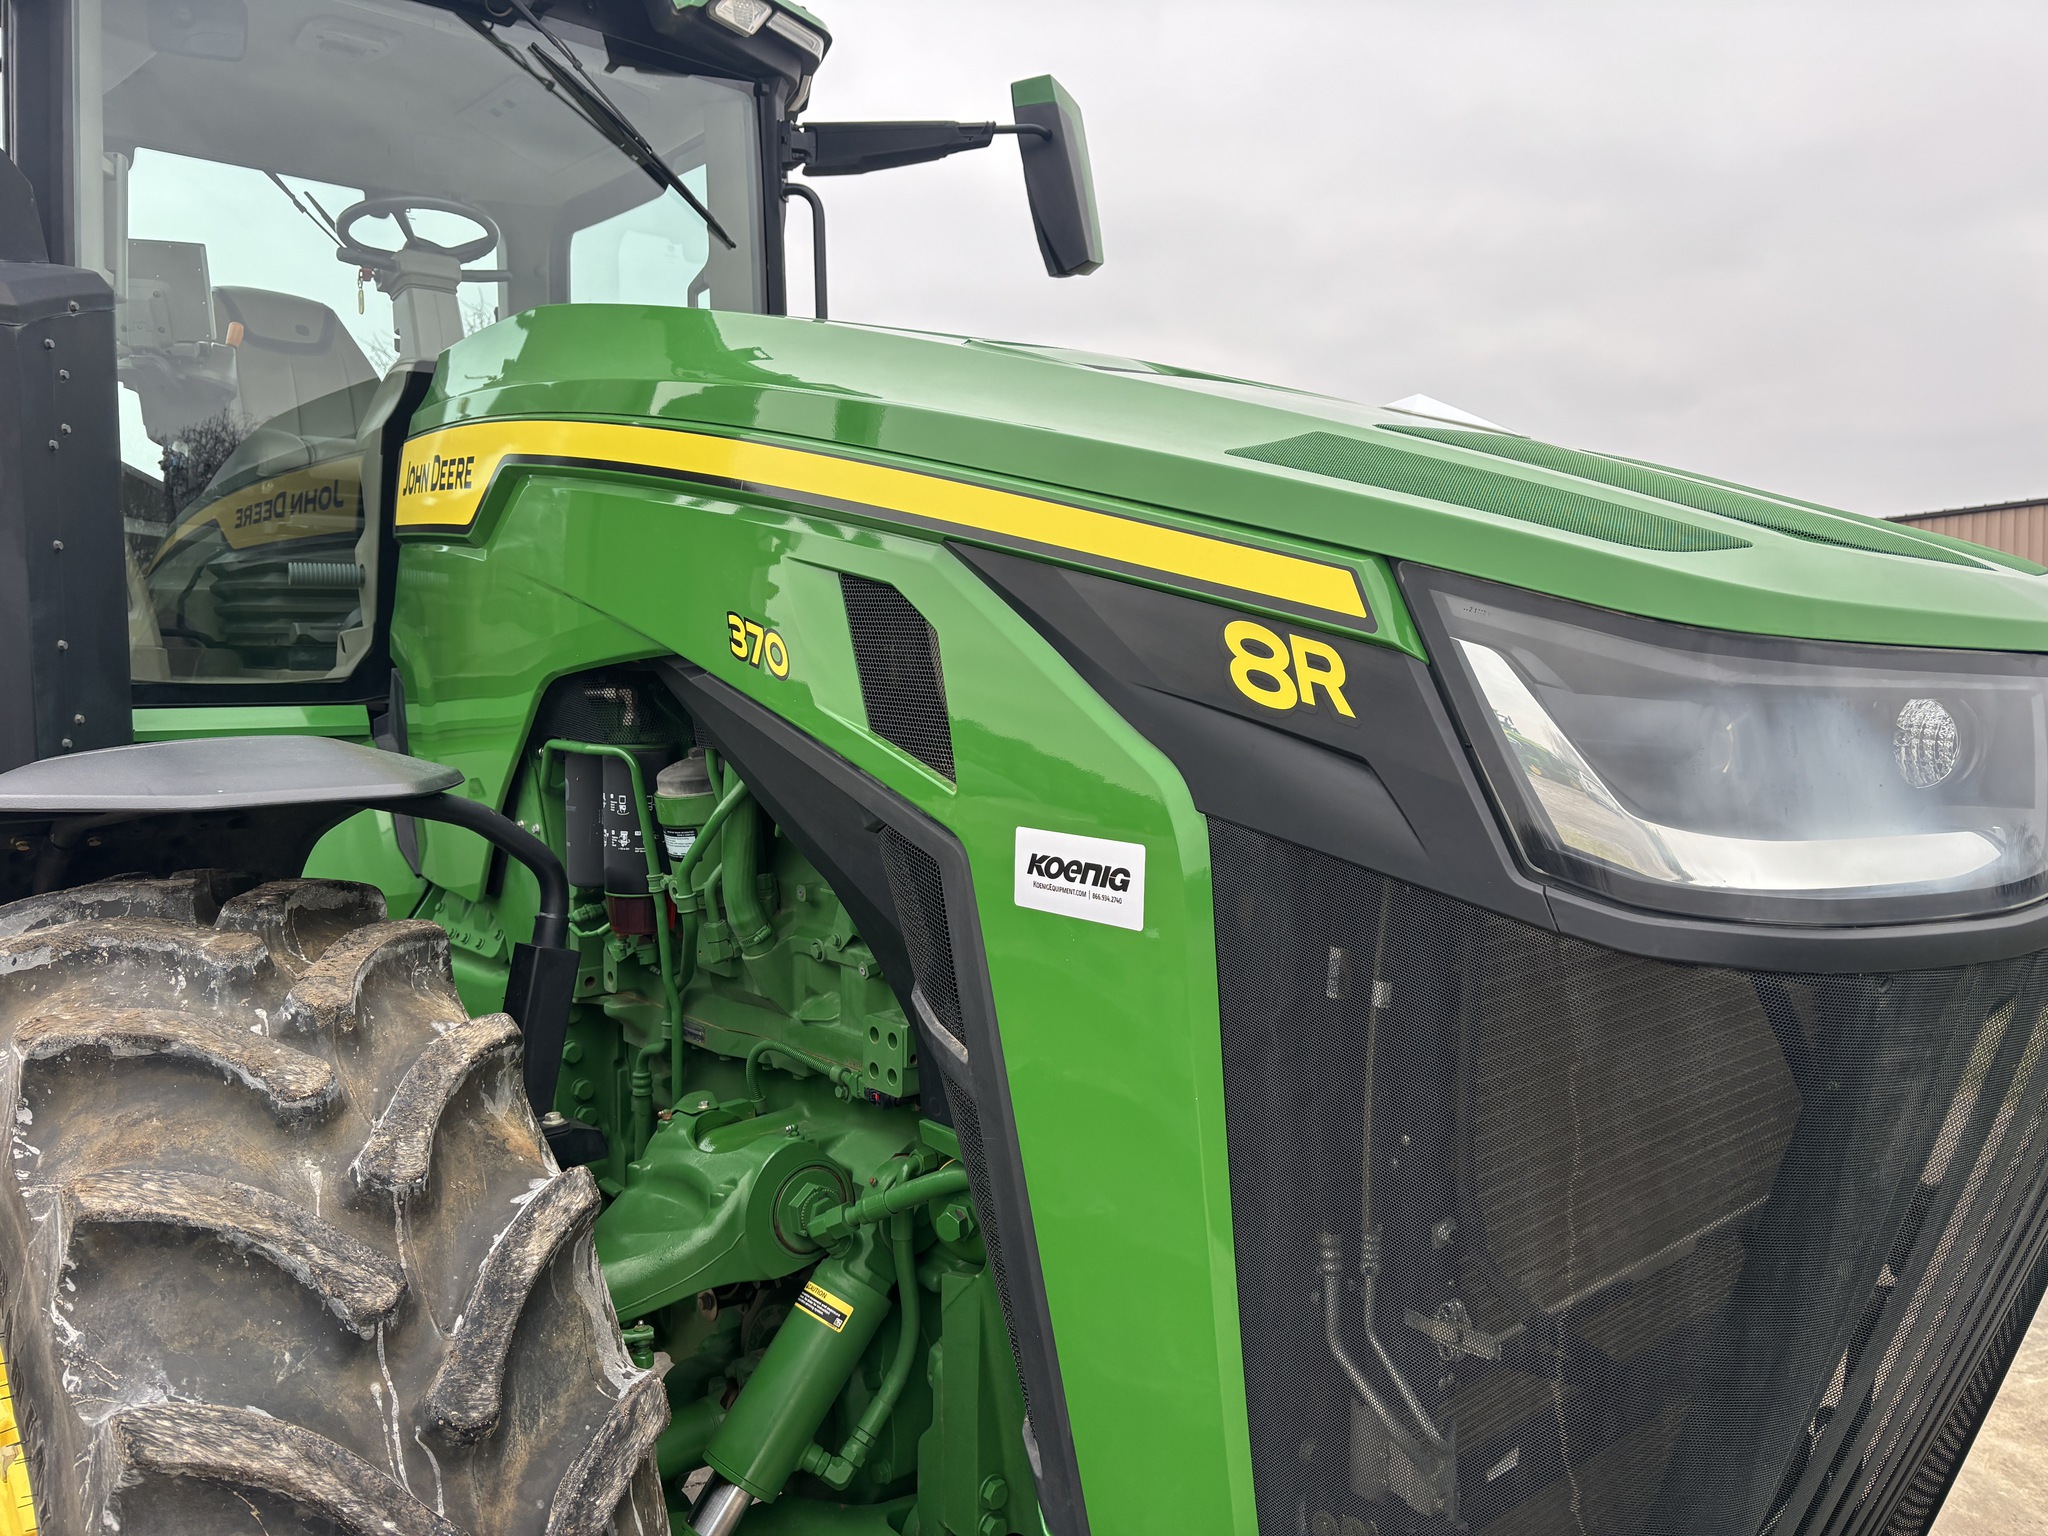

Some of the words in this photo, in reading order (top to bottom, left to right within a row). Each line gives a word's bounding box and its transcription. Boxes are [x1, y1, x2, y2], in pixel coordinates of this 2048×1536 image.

[402, 461, 430, 497] JOHN
[430, 455, 475, 492] DEERE
[726, 611, 790, 681] 370
[1224, 620, 1357, 719] 8R
[806, 1283, 828, 1298] CAUTION
